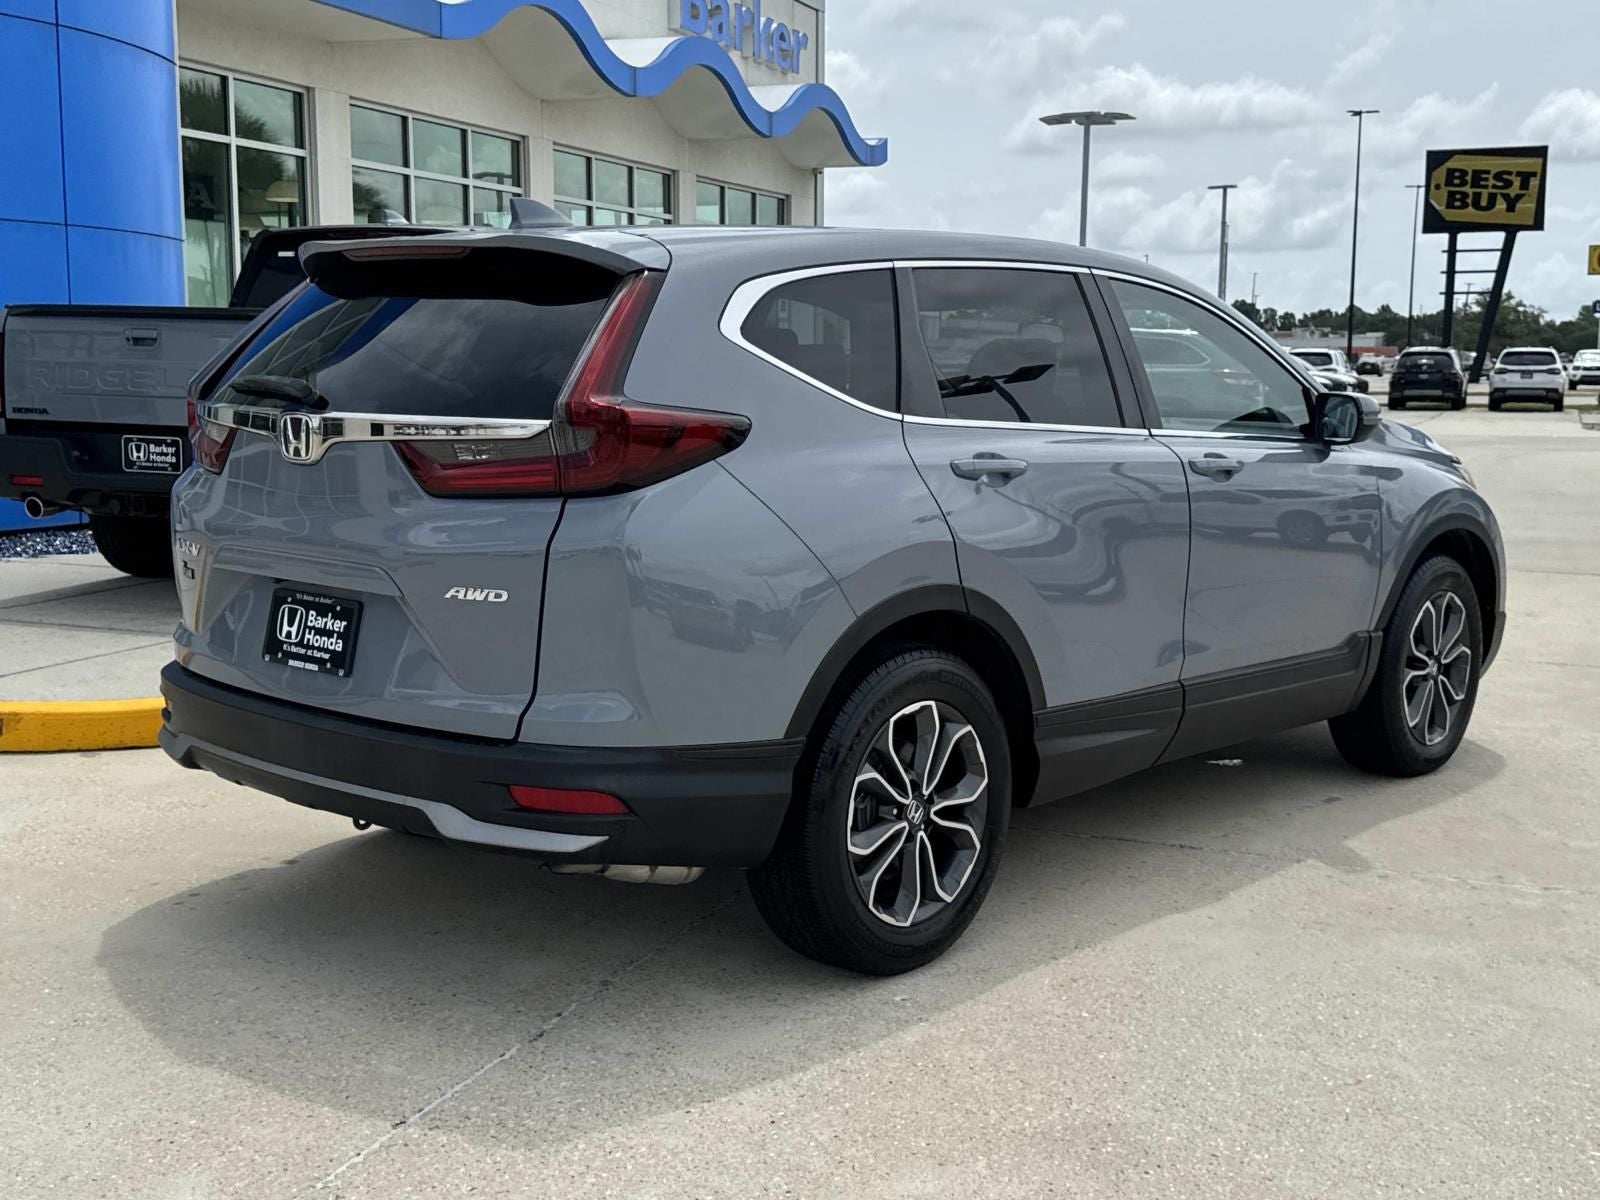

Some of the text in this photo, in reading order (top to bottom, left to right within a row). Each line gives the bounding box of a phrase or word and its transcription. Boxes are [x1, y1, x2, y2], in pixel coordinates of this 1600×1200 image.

[1444, 168, 1538, 191] BEST
[1445, 190, 1527, 213] BUY
[12, 406, 50, 416] HONDA
[149, 443, 176, 454] Barker
[149, 453, 176, 463] Honda
[444, 586, 509, 602] AWD
[307, 610, 347, 632] Barker
[303, 629, 343, 651] Honda
